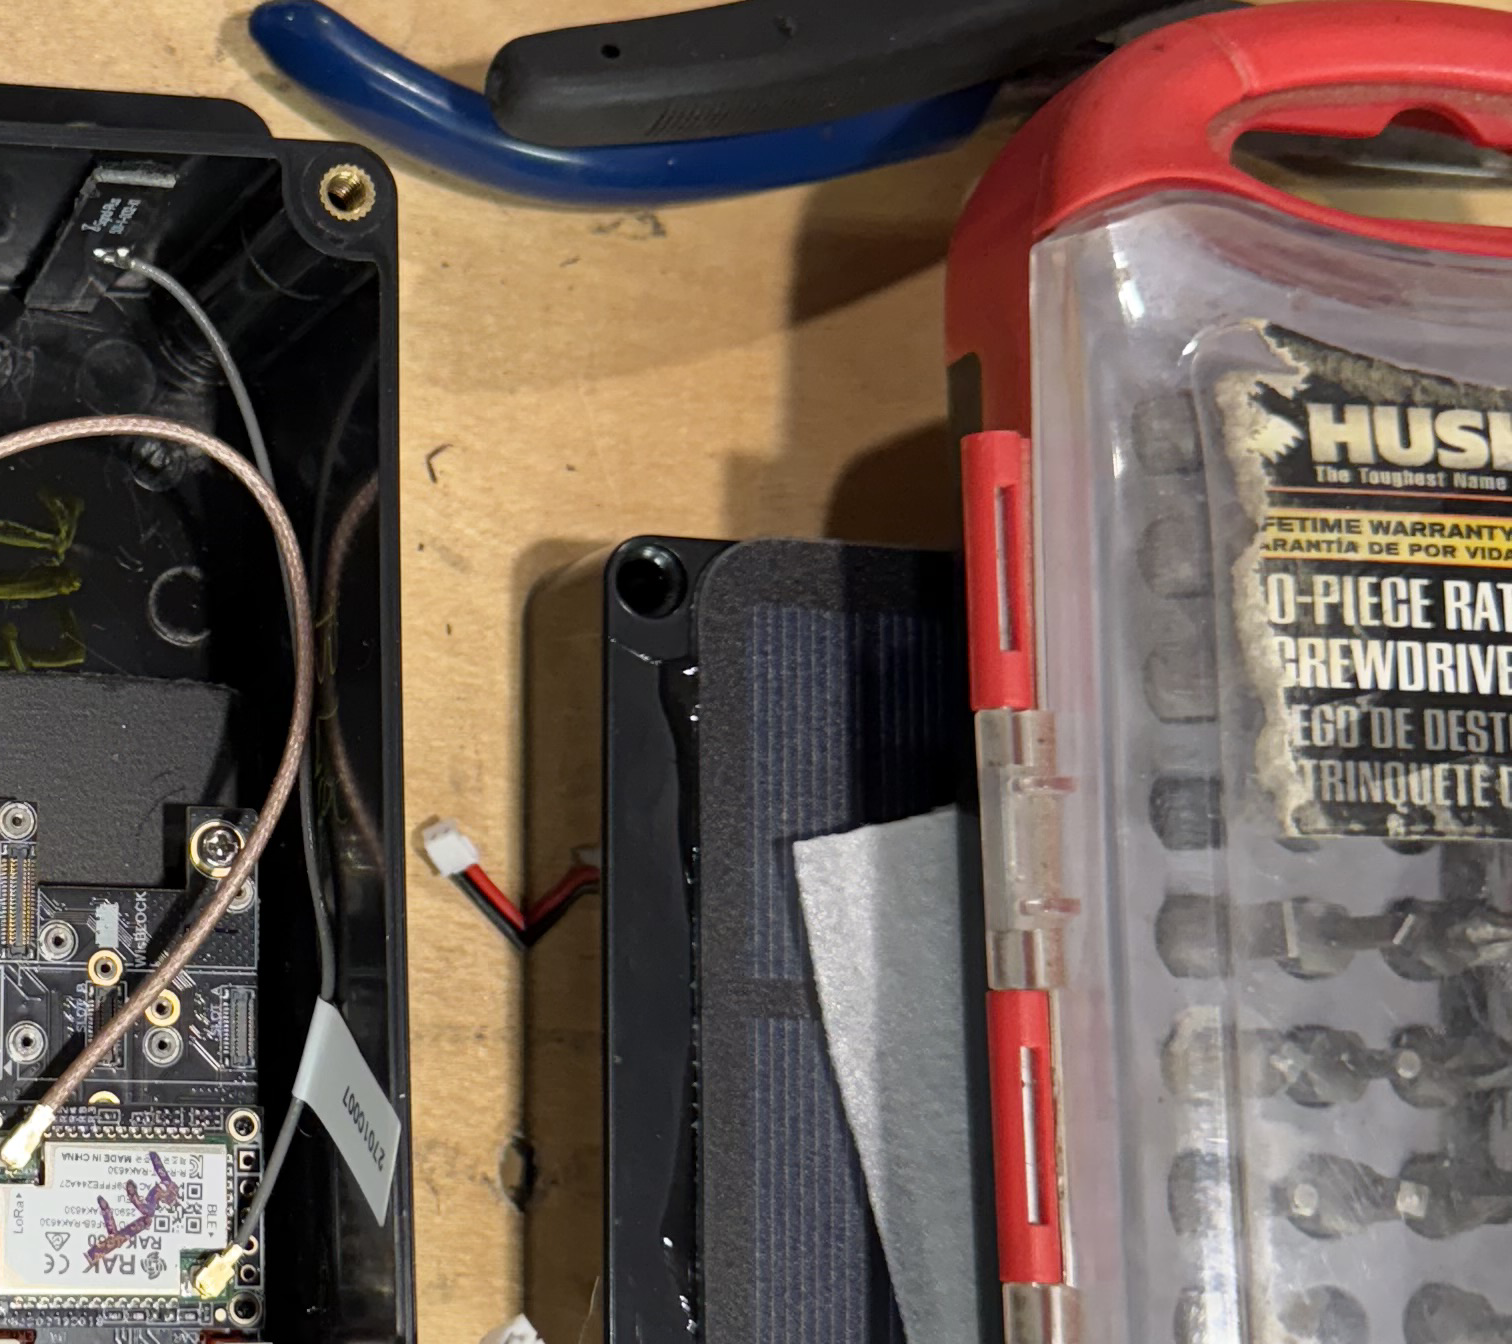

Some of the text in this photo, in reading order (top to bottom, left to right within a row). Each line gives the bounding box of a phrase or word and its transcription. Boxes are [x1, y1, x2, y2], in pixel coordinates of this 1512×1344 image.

[1314, 466, 1508, 492] The Toughest Name
[1368, 542, 1400, 557] DE
[1408, 543, 1457, 560] POR
[1371, 707, 1415, 751] DE
[1424, 709, 1512, 754] DEST
[61, 1152, 132, 1164] MADE IN CHINA
[13, 1200, 24, 1234] LoRa
[207, 1204, 218, 1229] BLE
[82, 1251, 136, 1275] RAK
